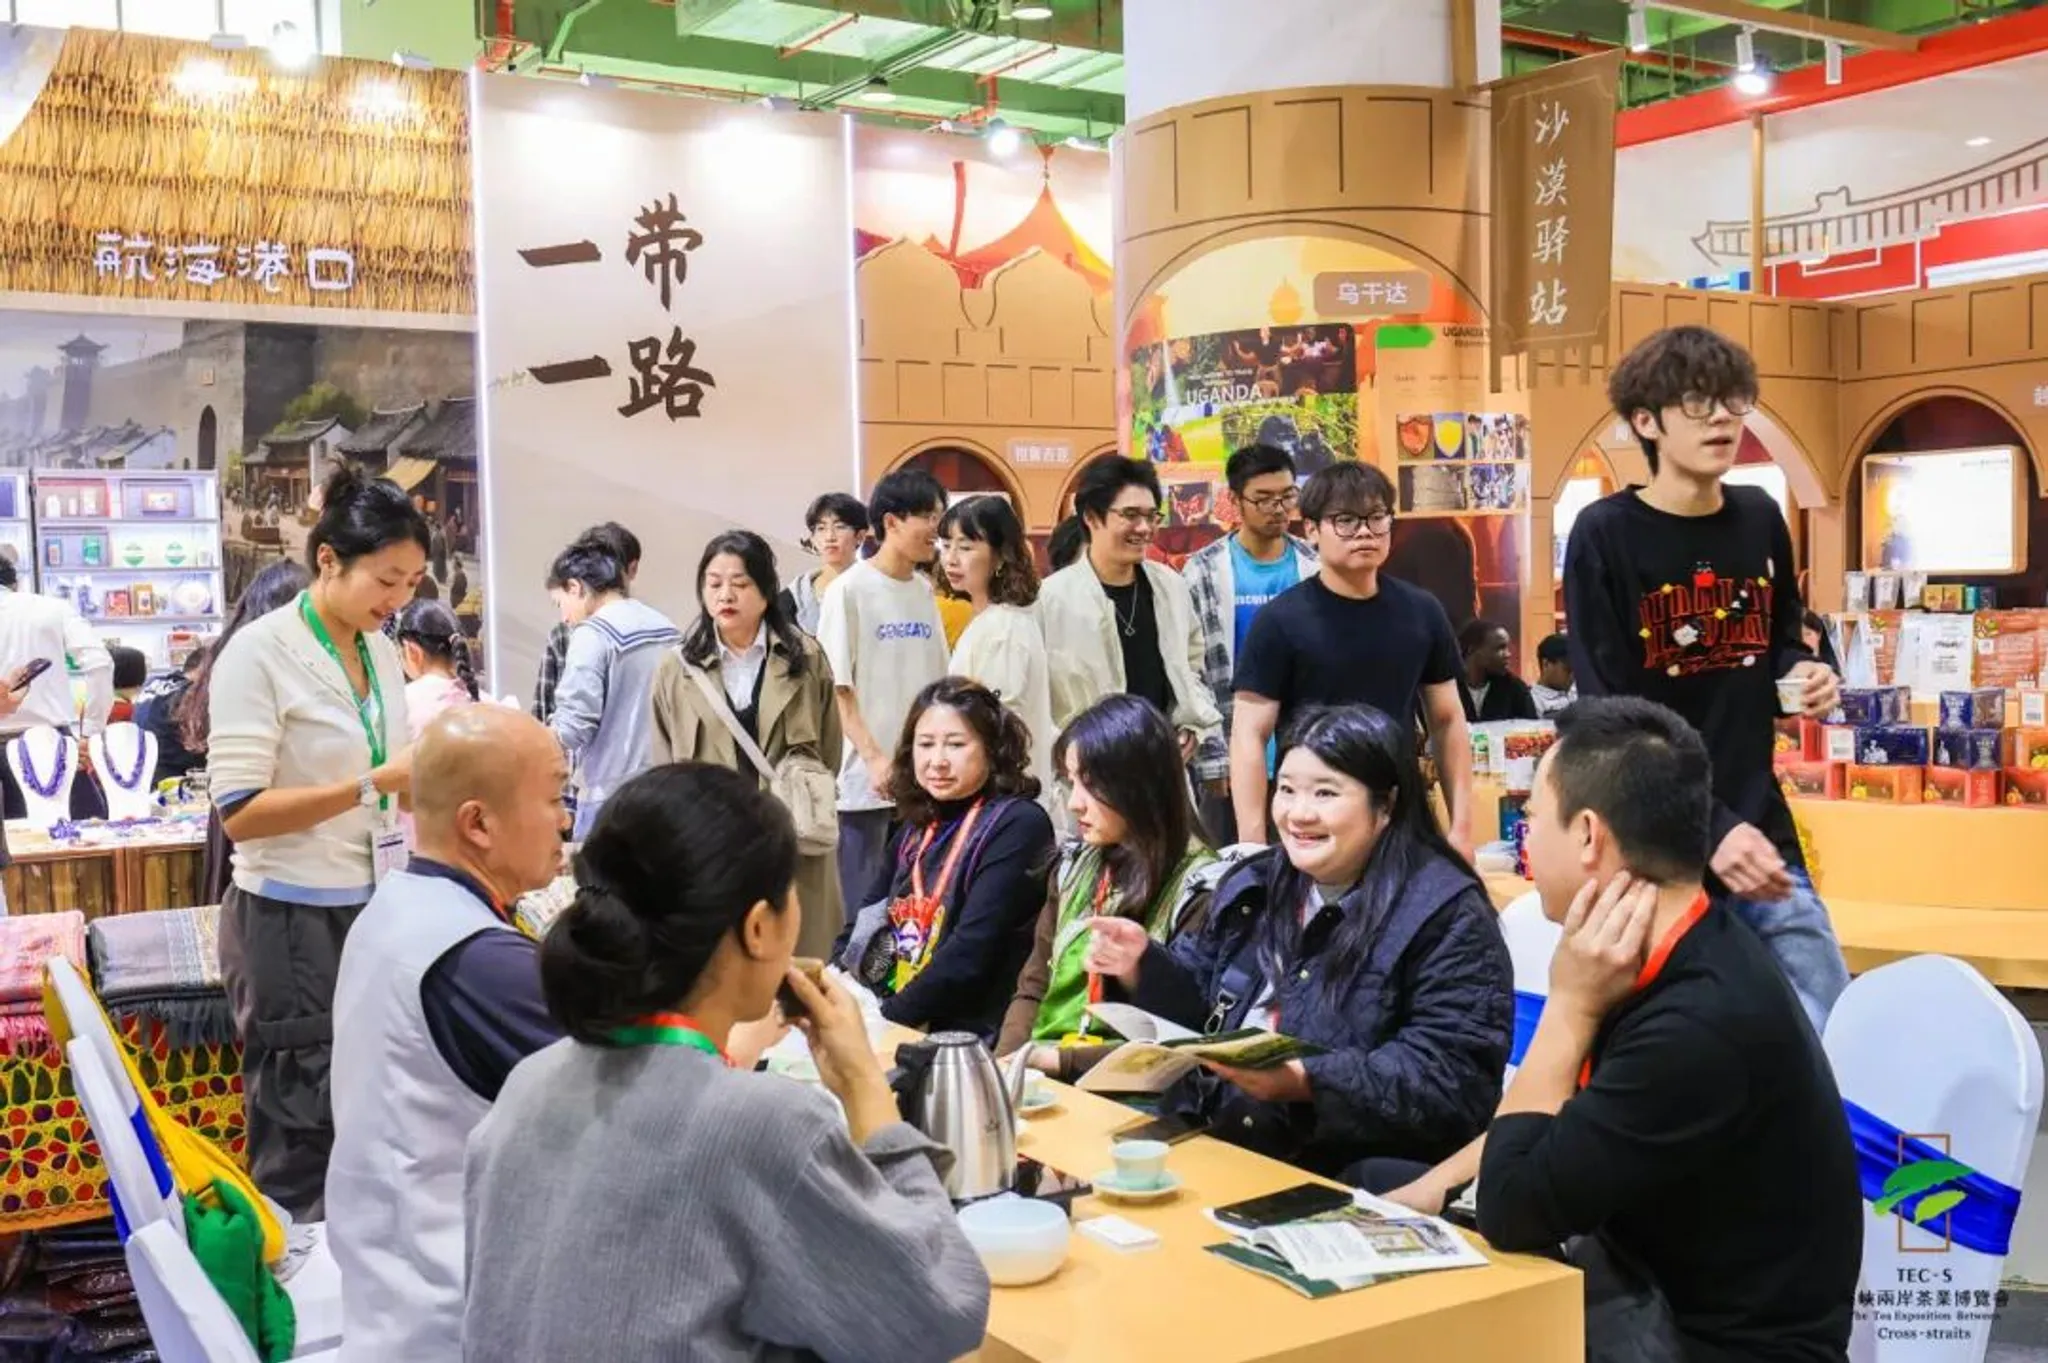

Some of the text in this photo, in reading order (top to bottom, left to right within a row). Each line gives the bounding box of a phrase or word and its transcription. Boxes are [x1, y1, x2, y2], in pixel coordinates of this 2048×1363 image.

[516, 191, 704, 313] 一带
[1528, 100, 1571, 327] 沙漠驿站
[93, 230, 357, 293] 航海港口
[1336, 279, 1409, 306] 乌干达
[526, 324, 716, 423] 一路
[1185, 382, 1263, 406] UGANDA
